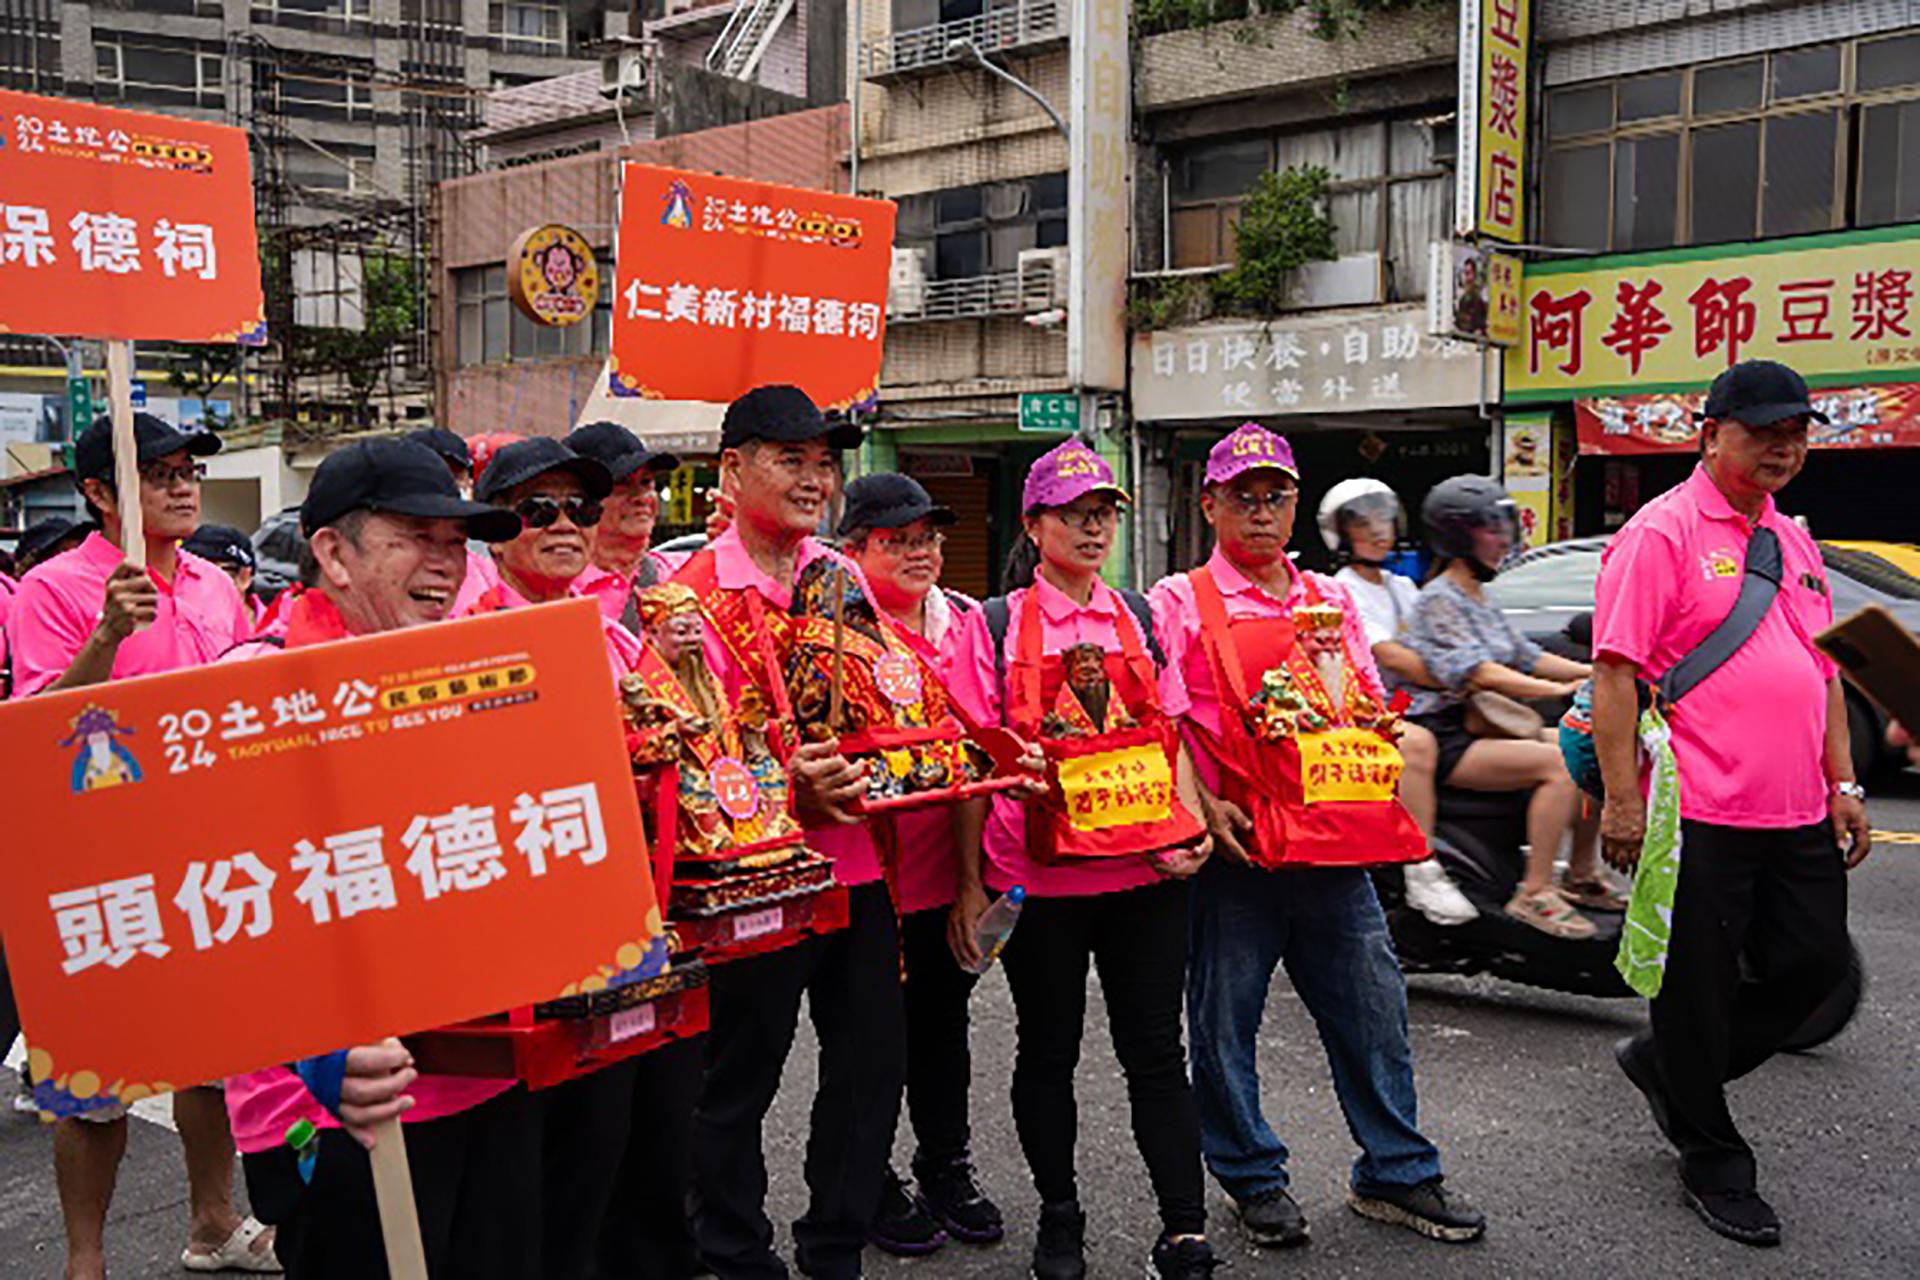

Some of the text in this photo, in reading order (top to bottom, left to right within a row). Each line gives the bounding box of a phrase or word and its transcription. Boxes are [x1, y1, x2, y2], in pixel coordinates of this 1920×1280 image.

[624, 278, 880, 340] 仁美新村福德祠
[220, 679, 378, 740] 土地公
[427, 704, 463, 722] YOU
[48, 782, 607, 976] 頭份福德祠
